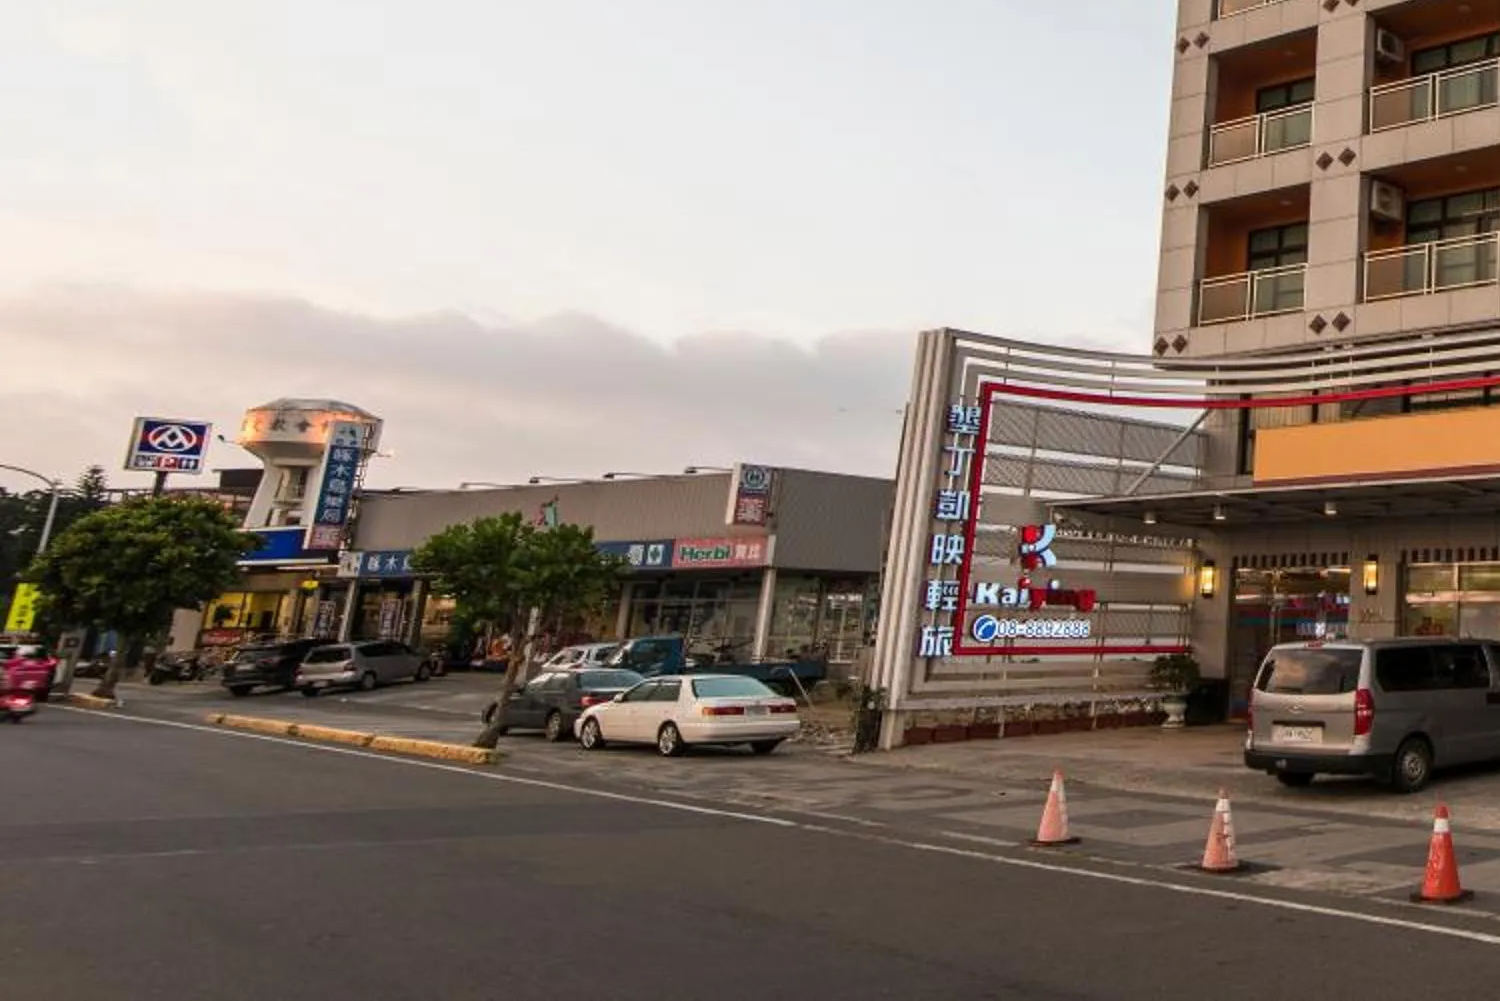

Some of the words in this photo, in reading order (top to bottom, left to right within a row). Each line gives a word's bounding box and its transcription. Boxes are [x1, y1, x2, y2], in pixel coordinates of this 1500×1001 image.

[919, 404, 982, 657] 墾丁凱映輕旅
